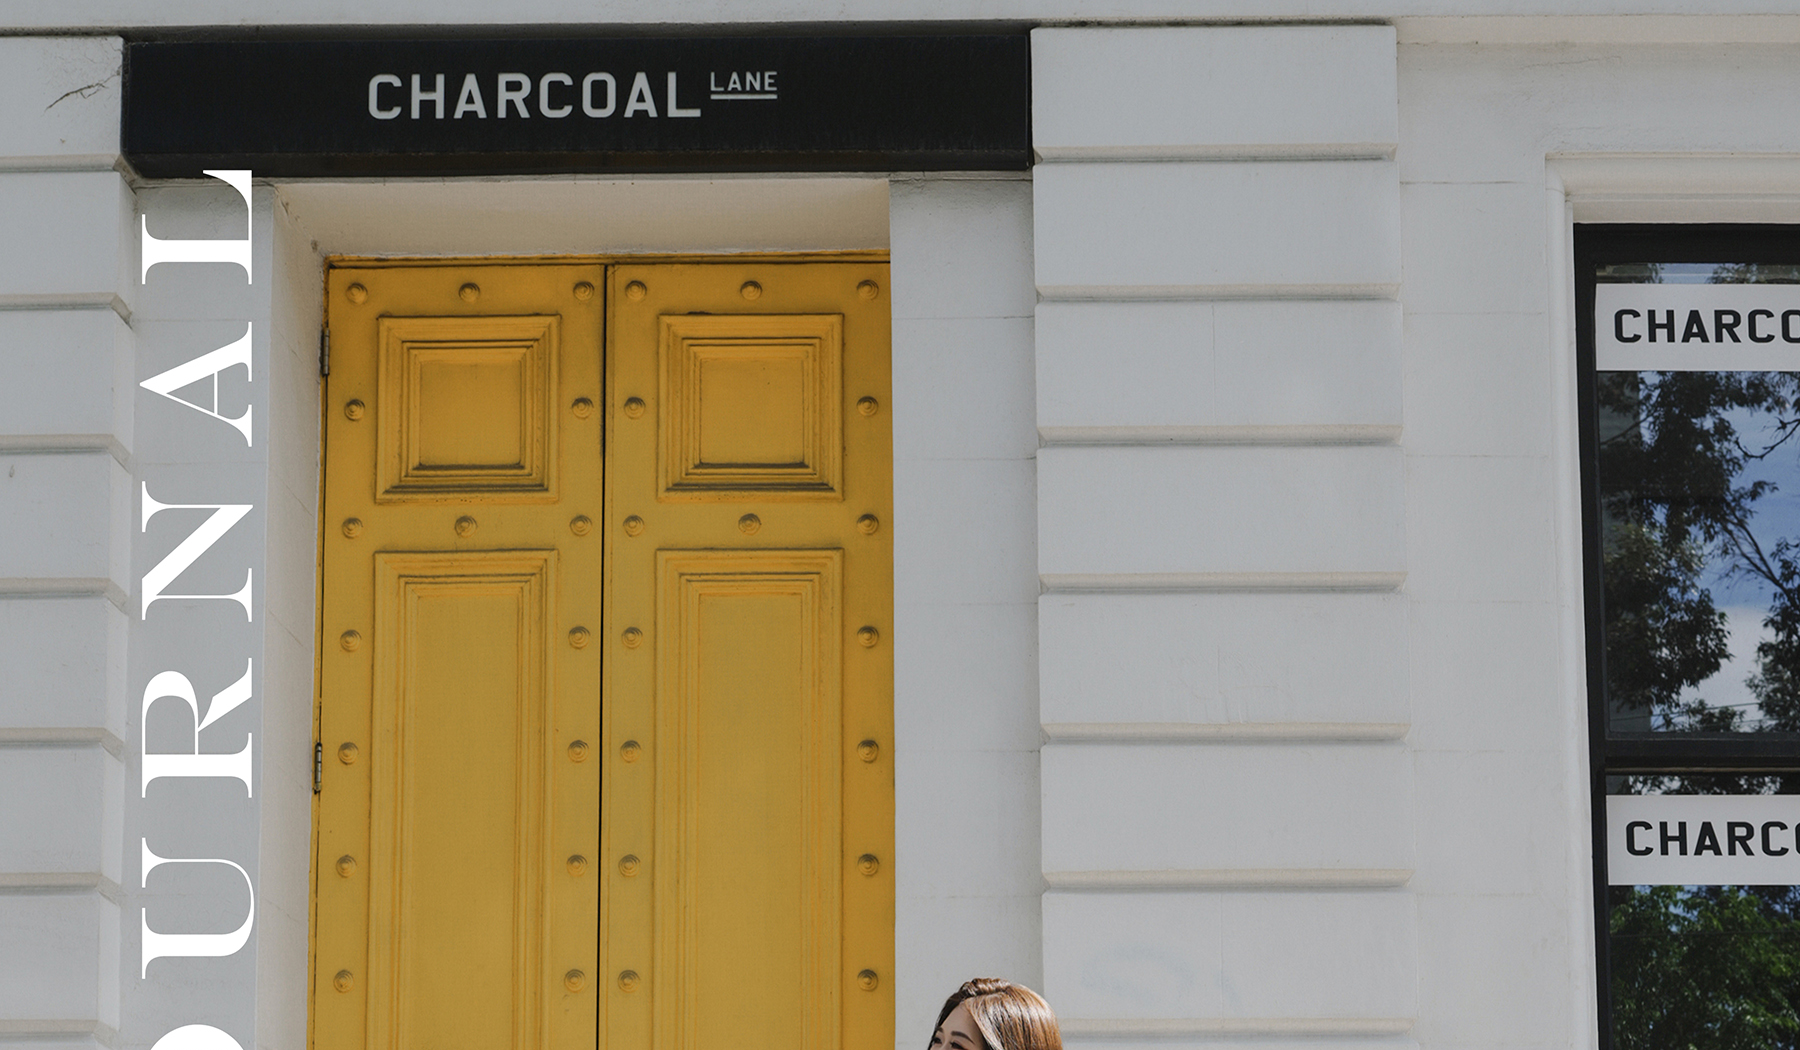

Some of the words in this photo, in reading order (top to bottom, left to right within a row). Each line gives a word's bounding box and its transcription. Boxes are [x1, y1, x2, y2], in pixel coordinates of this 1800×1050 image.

[368, 72, 701, 120] CHARCOAL
[710, 72, 778, 92] LANE
[1613, 308, 1800, 344] CHARCO
[1625, 820, 1800, 857] CHARC
